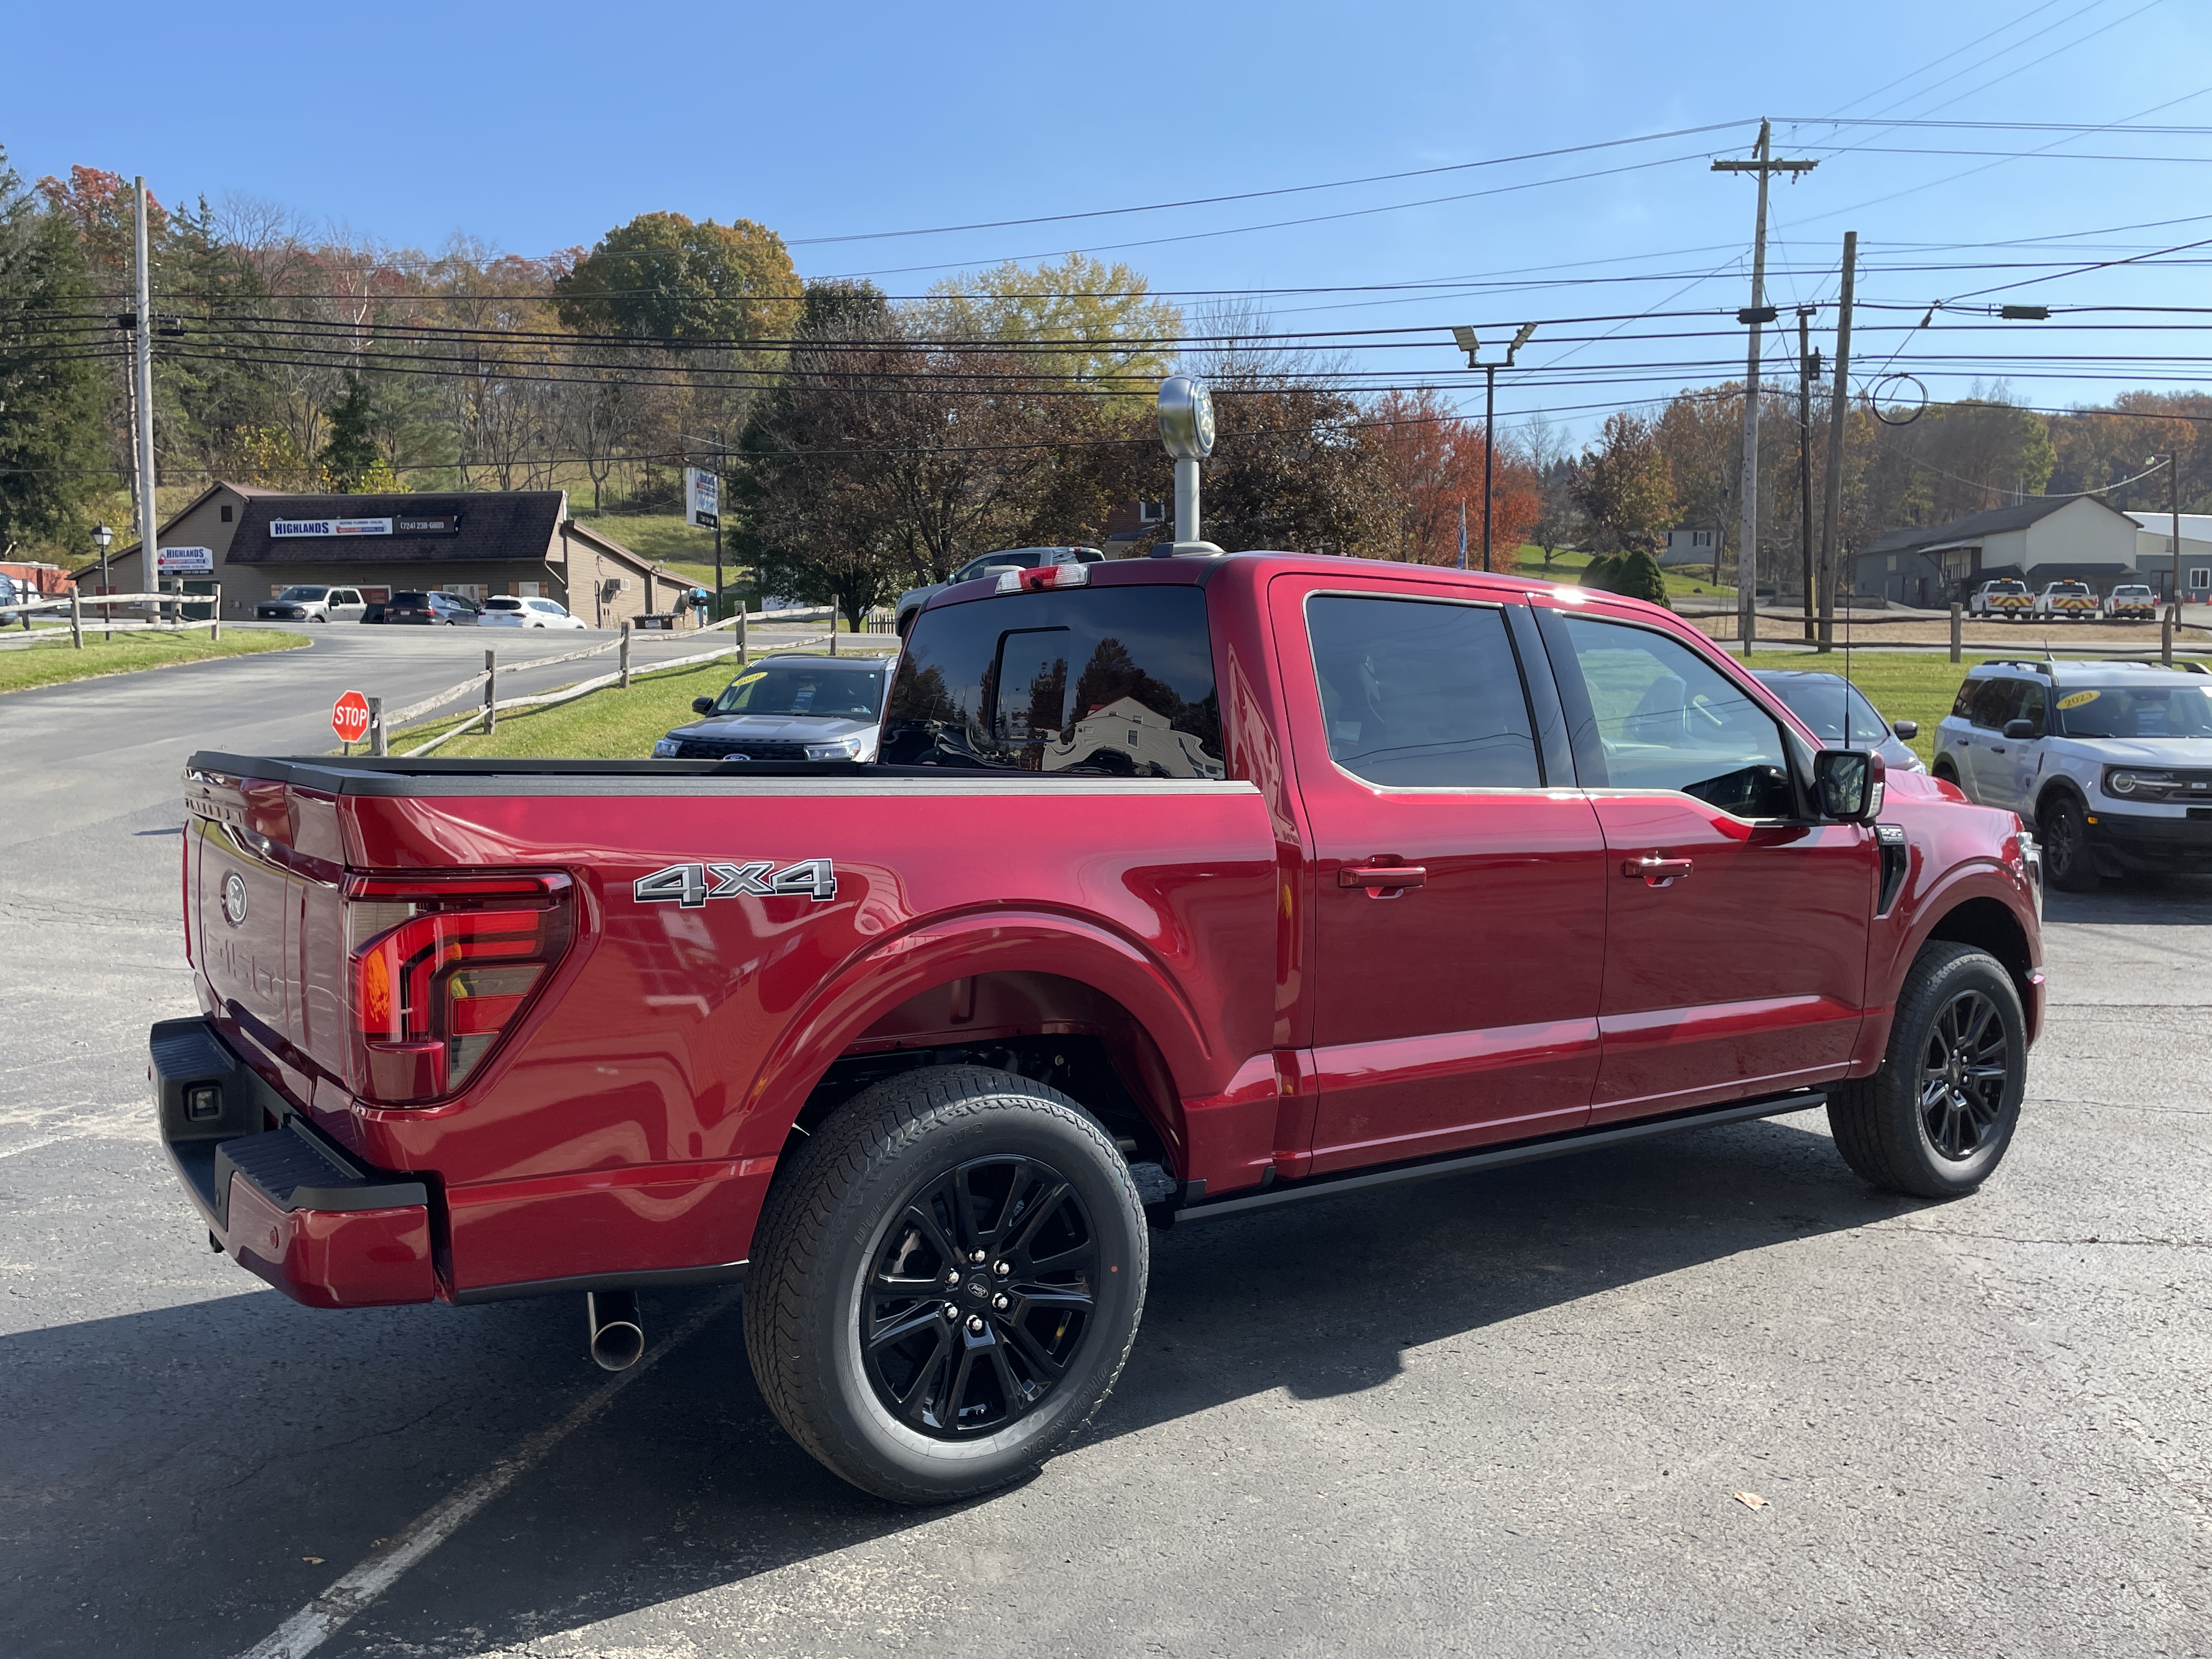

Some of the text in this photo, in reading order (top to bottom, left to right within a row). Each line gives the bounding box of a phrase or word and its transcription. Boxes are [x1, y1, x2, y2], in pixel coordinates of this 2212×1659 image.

[275, 522, 329, 534] HIGHLANDS
[166, 549, 204, 558] HIGHLANDS
[2064, 691, 2093, 708] 2023
[335, 706, 367, 727] STOP
[633, 858, 838, 909] 4X4
[943, 1122, 984, 1149] AT2
